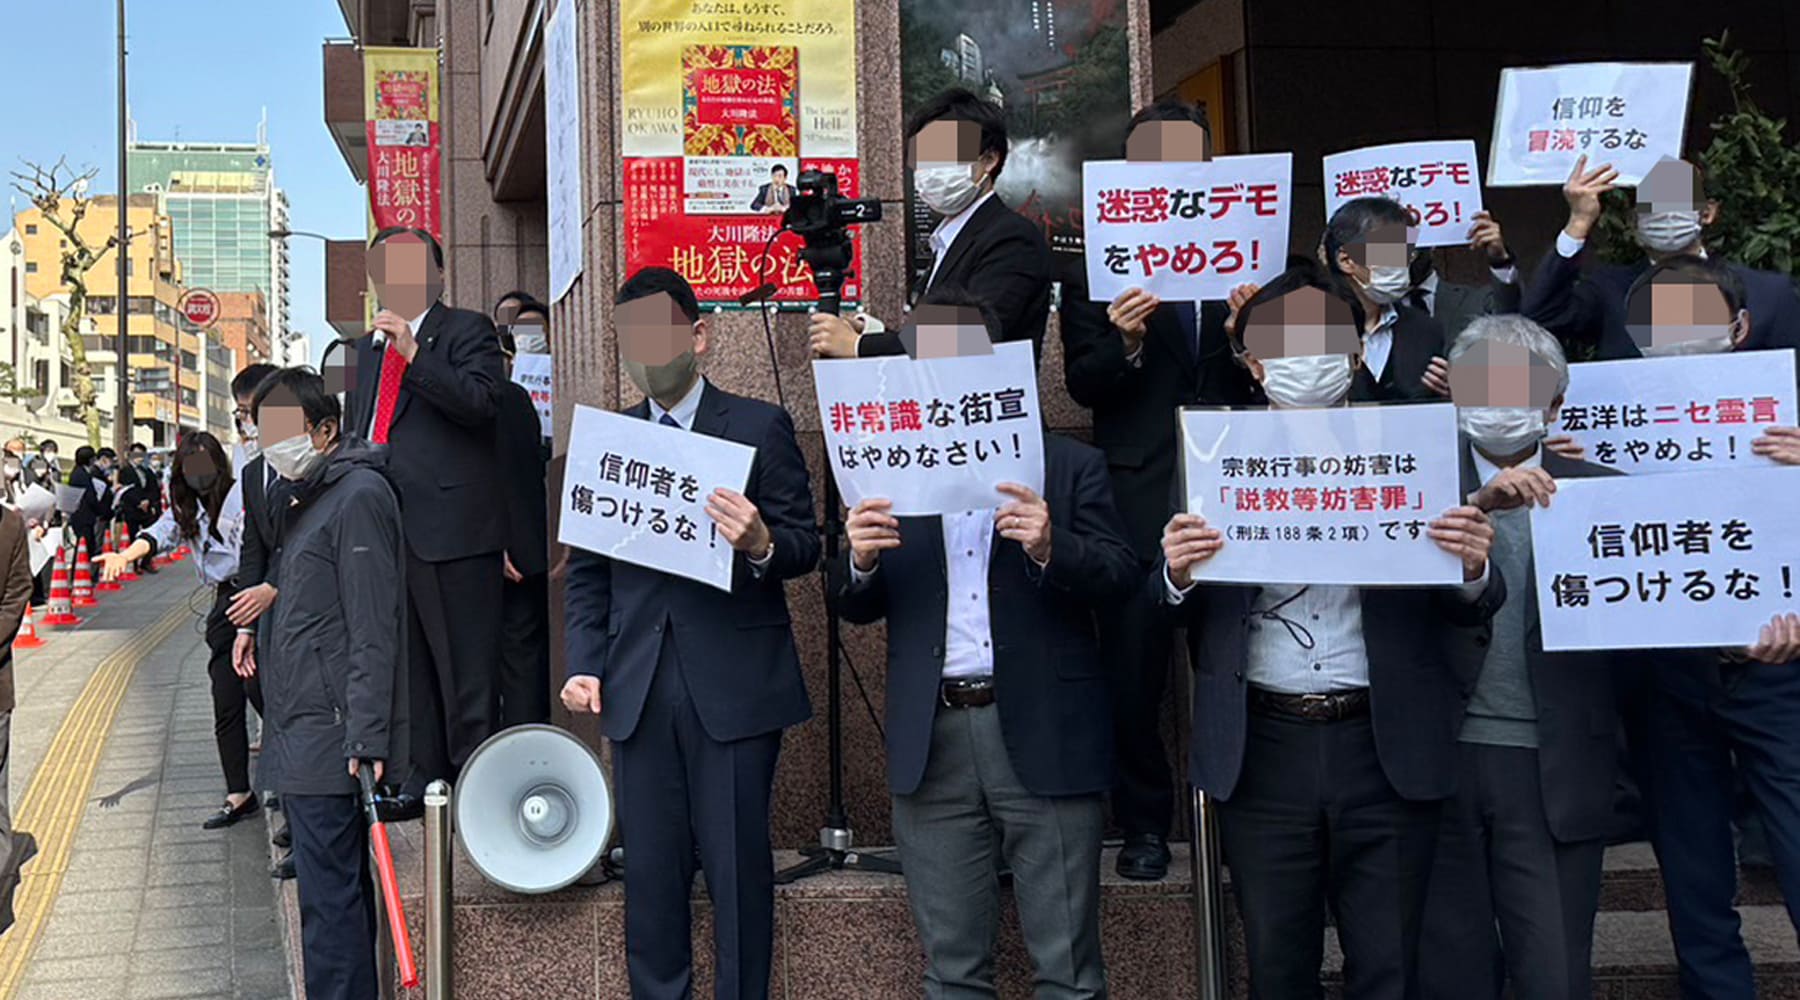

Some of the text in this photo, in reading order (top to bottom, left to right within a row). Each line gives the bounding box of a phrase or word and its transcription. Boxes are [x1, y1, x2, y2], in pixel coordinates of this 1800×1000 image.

[691, 3, 785, 15] あなたは、もうすぐ、
[701, 74, 777, 95] 地獄の法
[1552, 96, 1626, 120] 信仰を
[1528, 128, 1648, 152] 冒涜するな
[376, 151, 391, 207] 大川隆法
[392, 151, 421, 229] 地獄の
[1335, 161, 1470, 197] 迷惑なデモ
[856, 204, 865, 217] 2
[1097, 183, 1278, 223] 迷惑なデモ
[1404, 201, 1461, 227] めろ！
[707, 225, 778, 243] 大川隆法
[667, 245, 816, 284] 地獄の法
[1104, 240, 1259, 276] をやめろ！
[829, 388, 1028, 433] 非常識な街宣
[1561, 396, 1779, 431] 宏洋はニセ霊言
[838, 433, 1022, 470] はやめなさい！
[1222, 453, 1417, 477] 宗教行事の妨害は
[1595, 436, 1737, 464] をやめよ！
[599, 451, 699, 503] 信仰者を
[570, 484, 717, 548] 傷つけるな！
[1218, 485, 1425, 512] 「説教等妨害罪」
[1587, 519, 1753, 559] 信仰者を
[1550, 566, 1792, 608] 傷つけるな！
